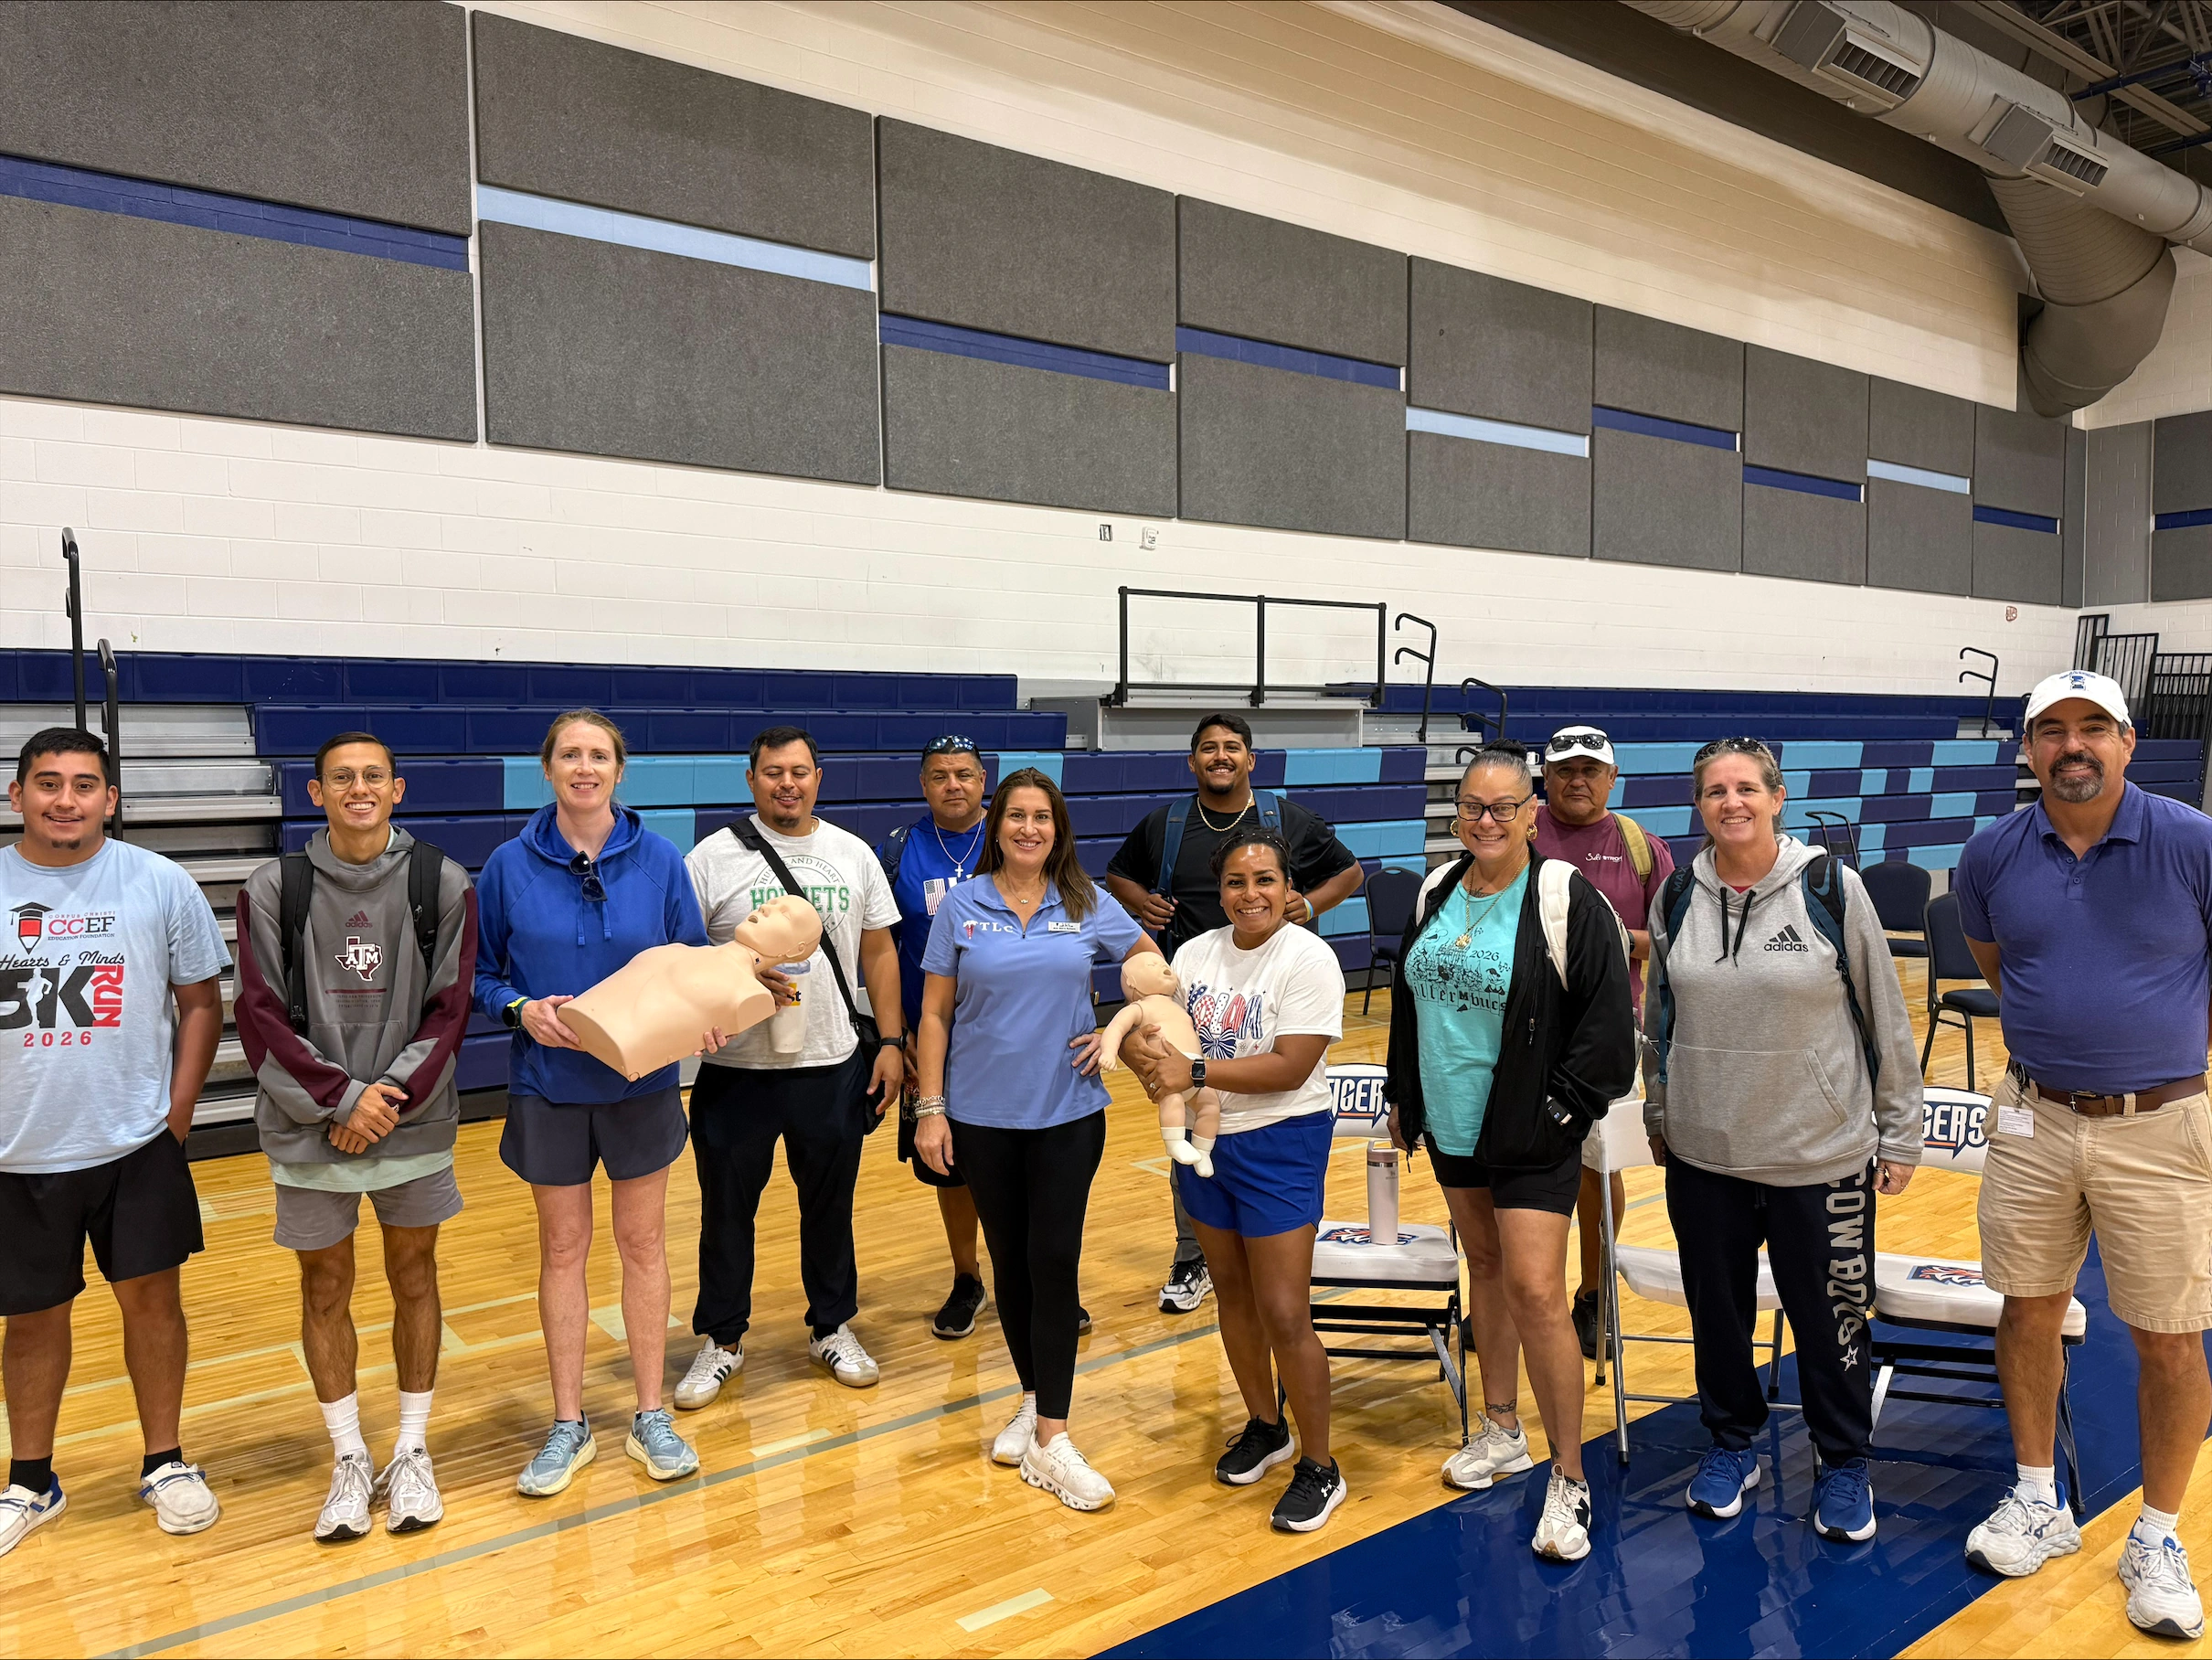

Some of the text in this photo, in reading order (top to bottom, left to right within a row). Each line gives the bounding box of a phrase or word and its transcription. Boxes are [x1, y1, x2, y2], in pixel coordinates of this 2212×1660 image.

[791, 857, 813, 865] AND
[815, 861, 840, 883] HEART
[750, 885, 850, 913] HOETS
[48, 916, 115, 935] CCEF
[979, 921, 1014, 933] TLC
[1470, 950, 1500, 962] 2026
[1763, 942, 1809, 952] adidas
[0, 951, 125, 968] Hearts & Minds
[0, 965, 97, 1029] 5K
[90, 965, 124, 1027] RUN
[1413, 981, 1455, 1003] iller
[24, 1031, 92, 1048] 2026
[1326, 1078, 1391, 1117] IGER
[1922, 1103, 1987, 1147] GERS
